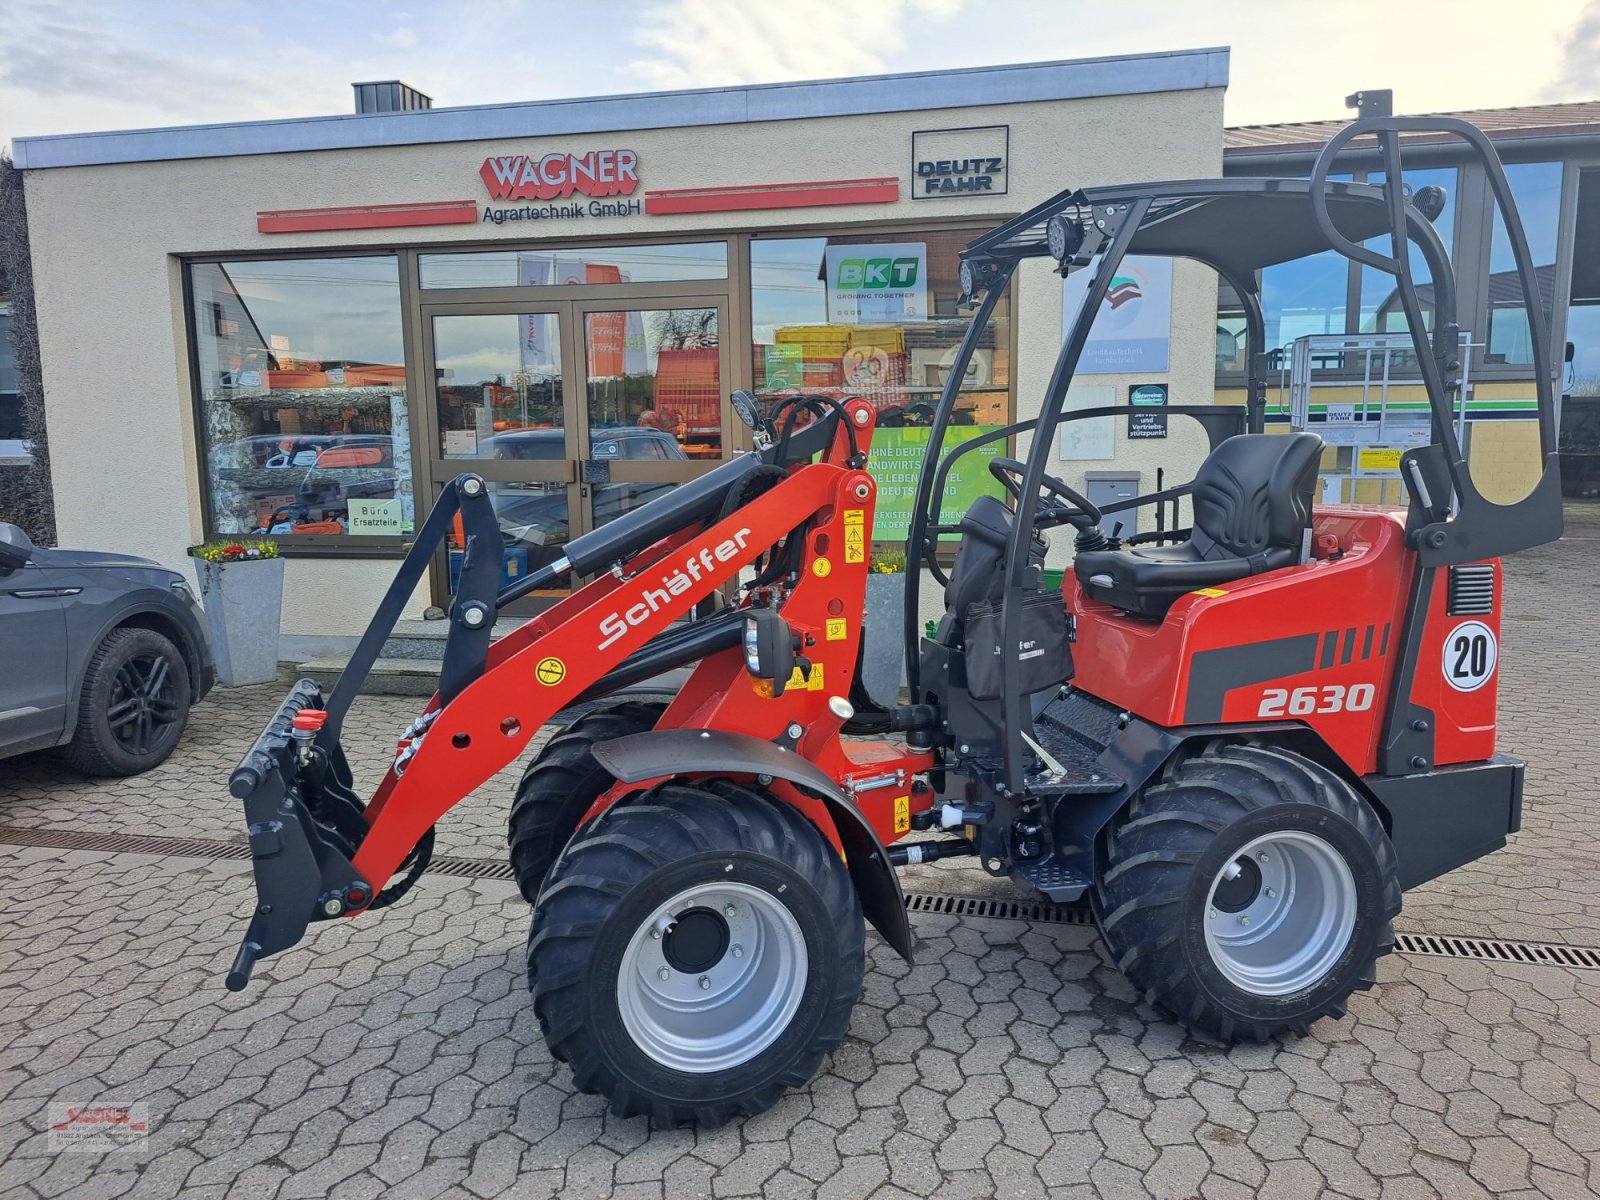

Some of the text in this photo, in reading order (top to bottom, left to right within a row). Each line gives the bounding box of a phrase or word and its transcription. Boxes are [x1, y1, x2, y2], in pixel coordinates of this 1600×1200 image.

[481, 149, 639, 196] WAGNER
[918, 157, 1002, 177] DEUTZ
[925, 175, 993, 194] FAHR
[482, 199, 641, 225] Agrartechnik GmbH
[838, 260, 917, 287] BKT
[874, 291, 915, 299] TOGETHER
[1140, 416, 1154, 424] und
[1130, 429, 1166, 438] stützpunkt
[361, 506, 389, 516] Büro
[353, 518, 398, 527] Ersatzteile
[597, 527, 751, 651] Schäffer
[1453, 634, 1488, 679] 20
[1257, 683, 1375, 718] 2630
